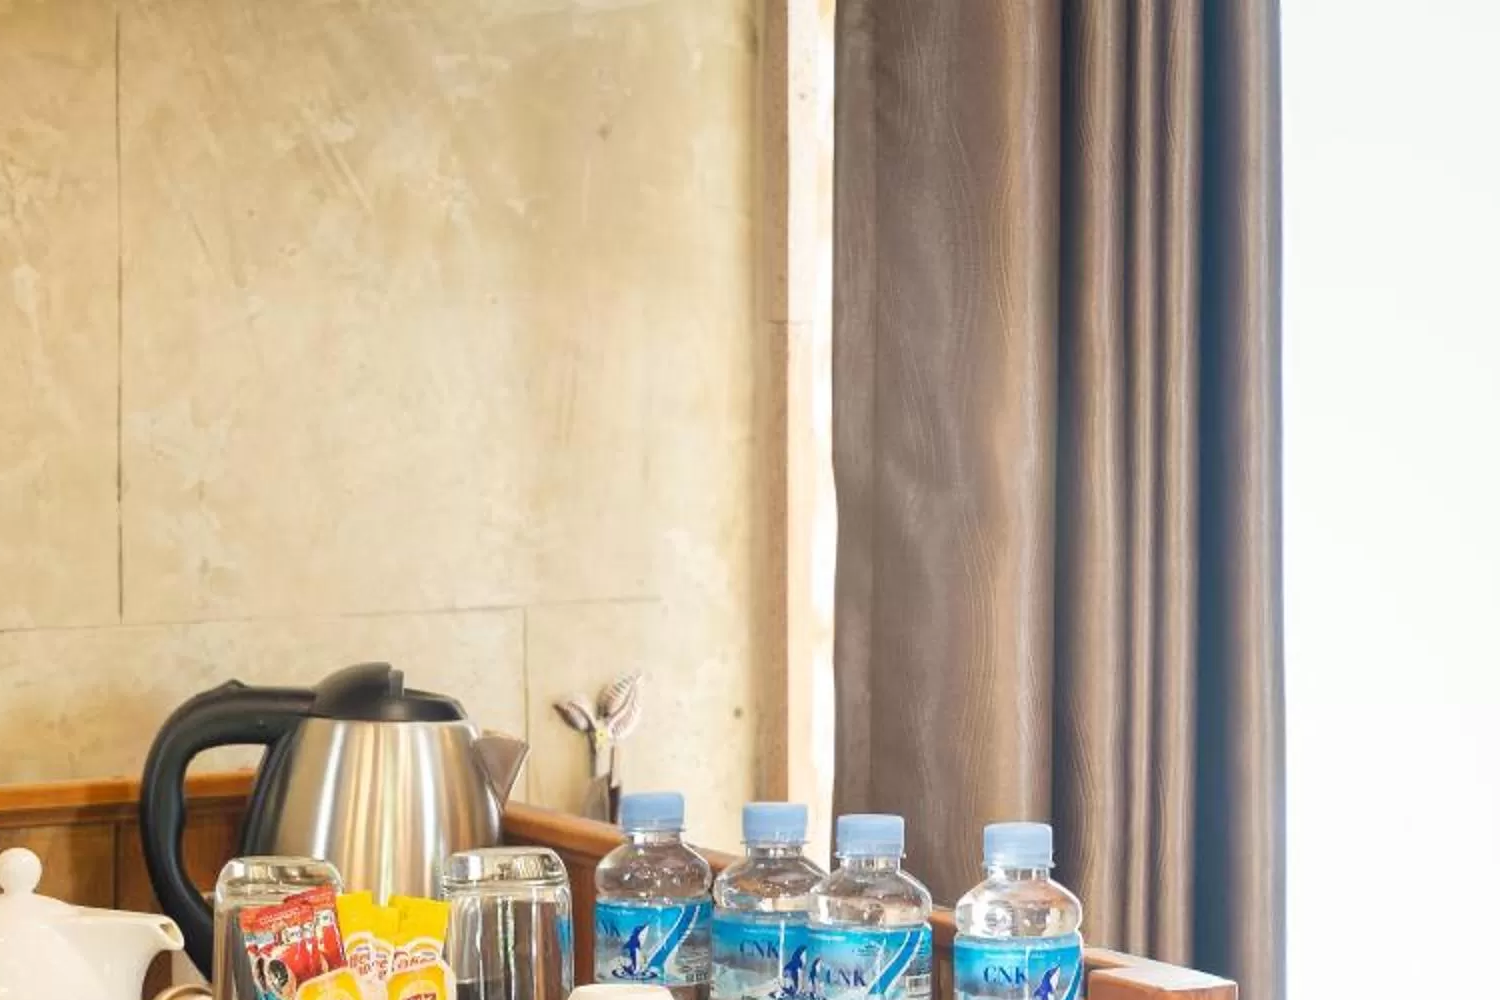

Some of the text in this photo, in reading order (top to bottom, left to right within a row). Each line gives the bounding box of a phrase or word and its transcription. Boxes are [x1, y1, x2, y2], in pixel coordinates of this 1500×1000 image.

[596, 919, 622, 938] NK
[826, 968, 867, 987] CNK
[983, 966, 1028, 985] CNK
